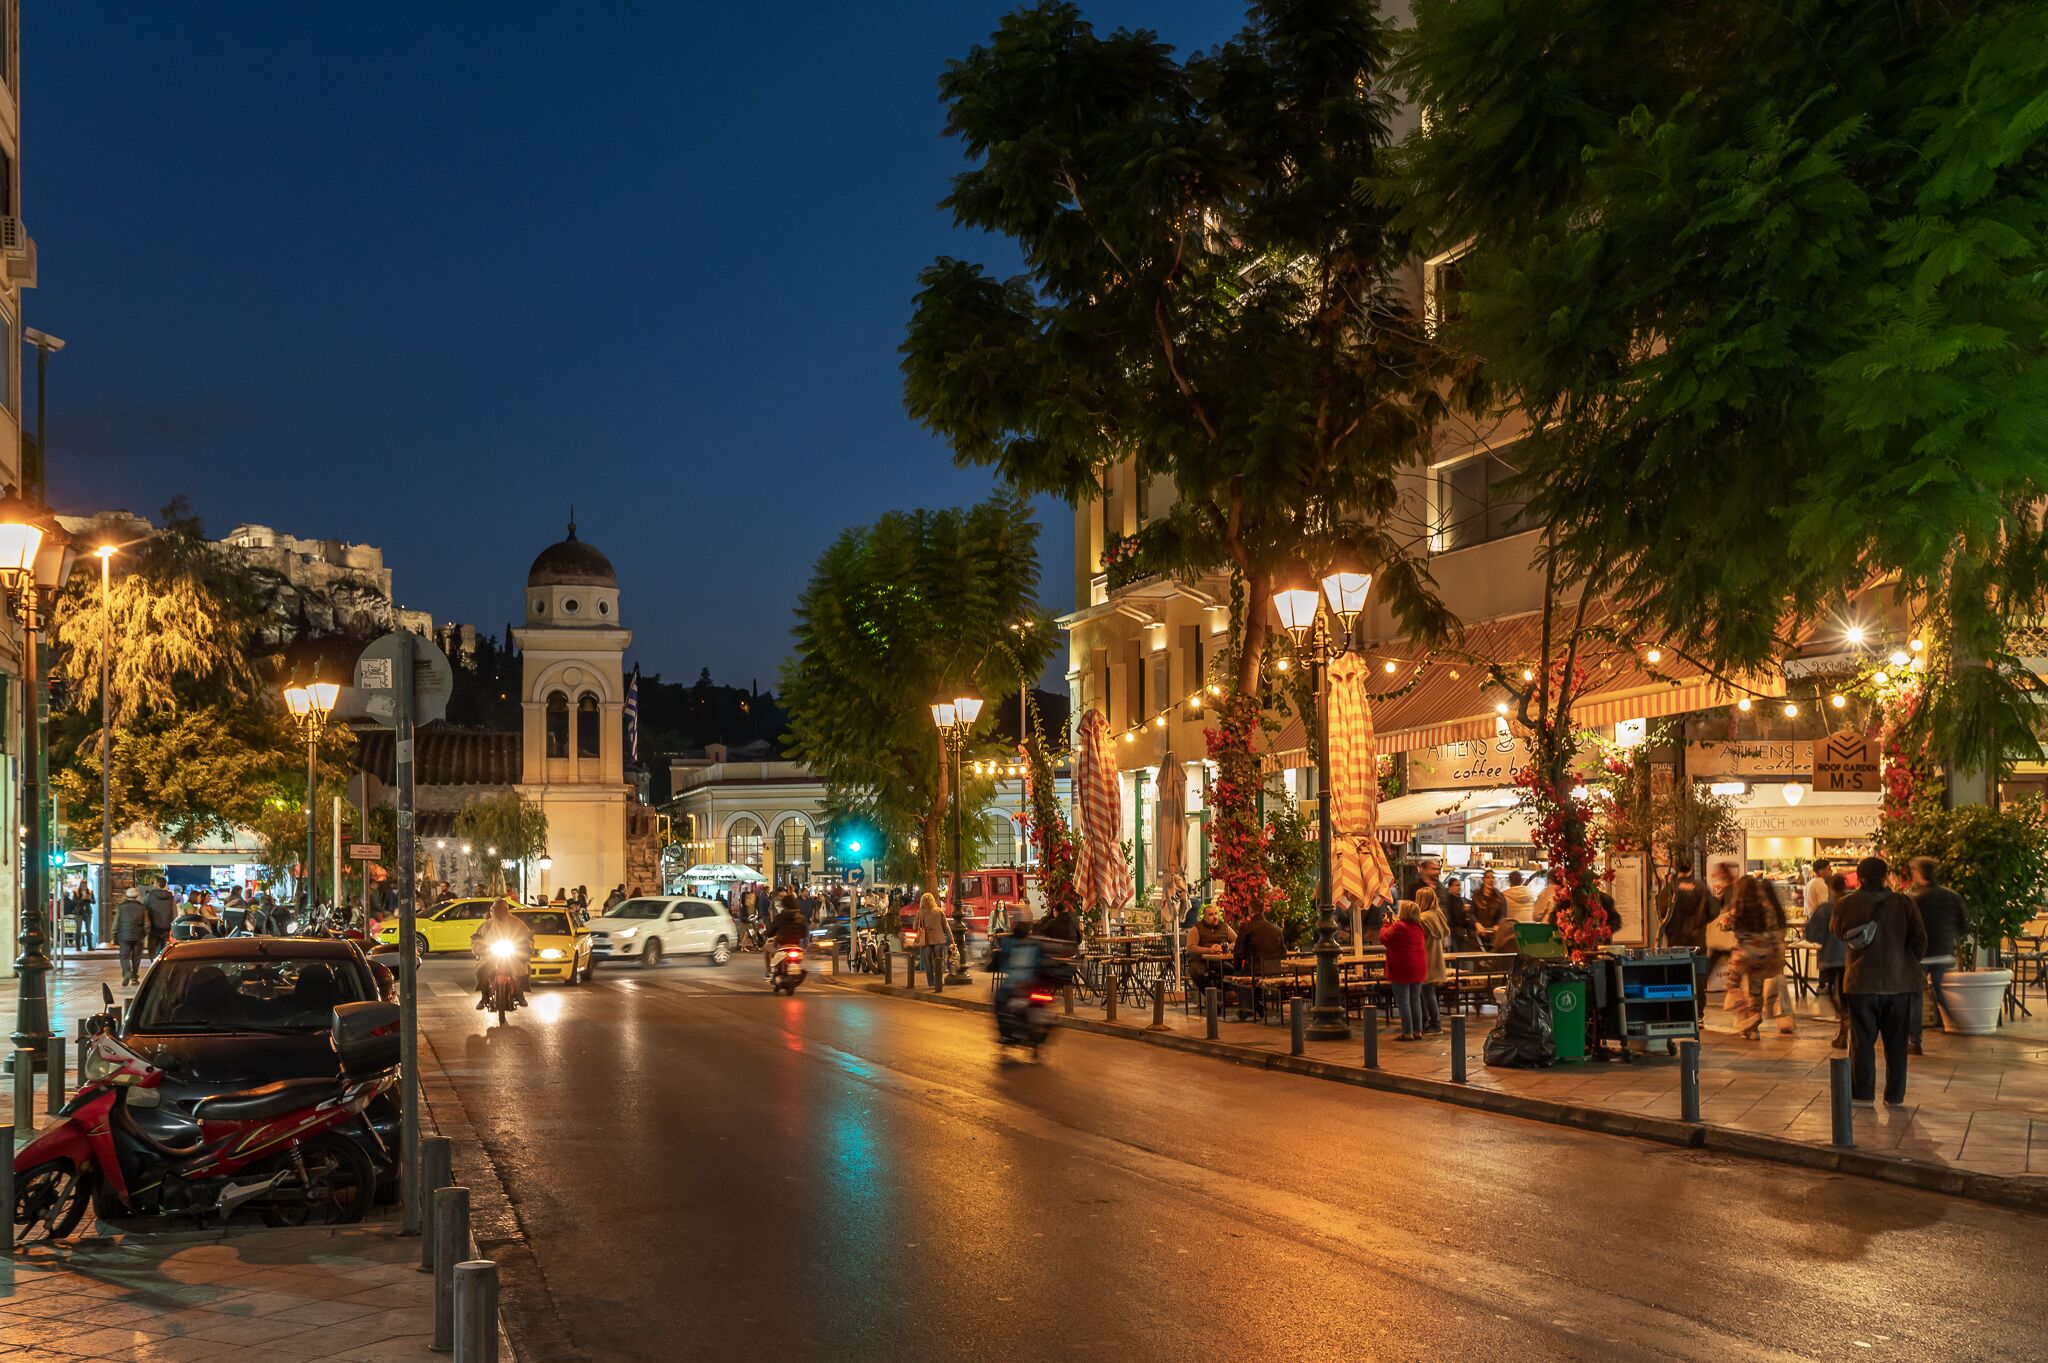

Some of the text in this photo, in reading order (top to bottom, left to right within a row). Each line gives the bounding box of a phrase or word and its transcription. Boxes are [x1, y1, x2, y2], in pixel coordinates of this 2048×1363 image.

[1719, 745, 1795, 760] ATHENS
[1453, 758, 1502, 780] coffee
[1753, 760, 1812, 771] coffee
[1818, 763, 1878, 772] ROOF GARDEN
[1744, 816, 1785, 829] BRUNCH
[1791, 818, 1806, 827] YOU
[1808, 817, 1830, 827] WANT
